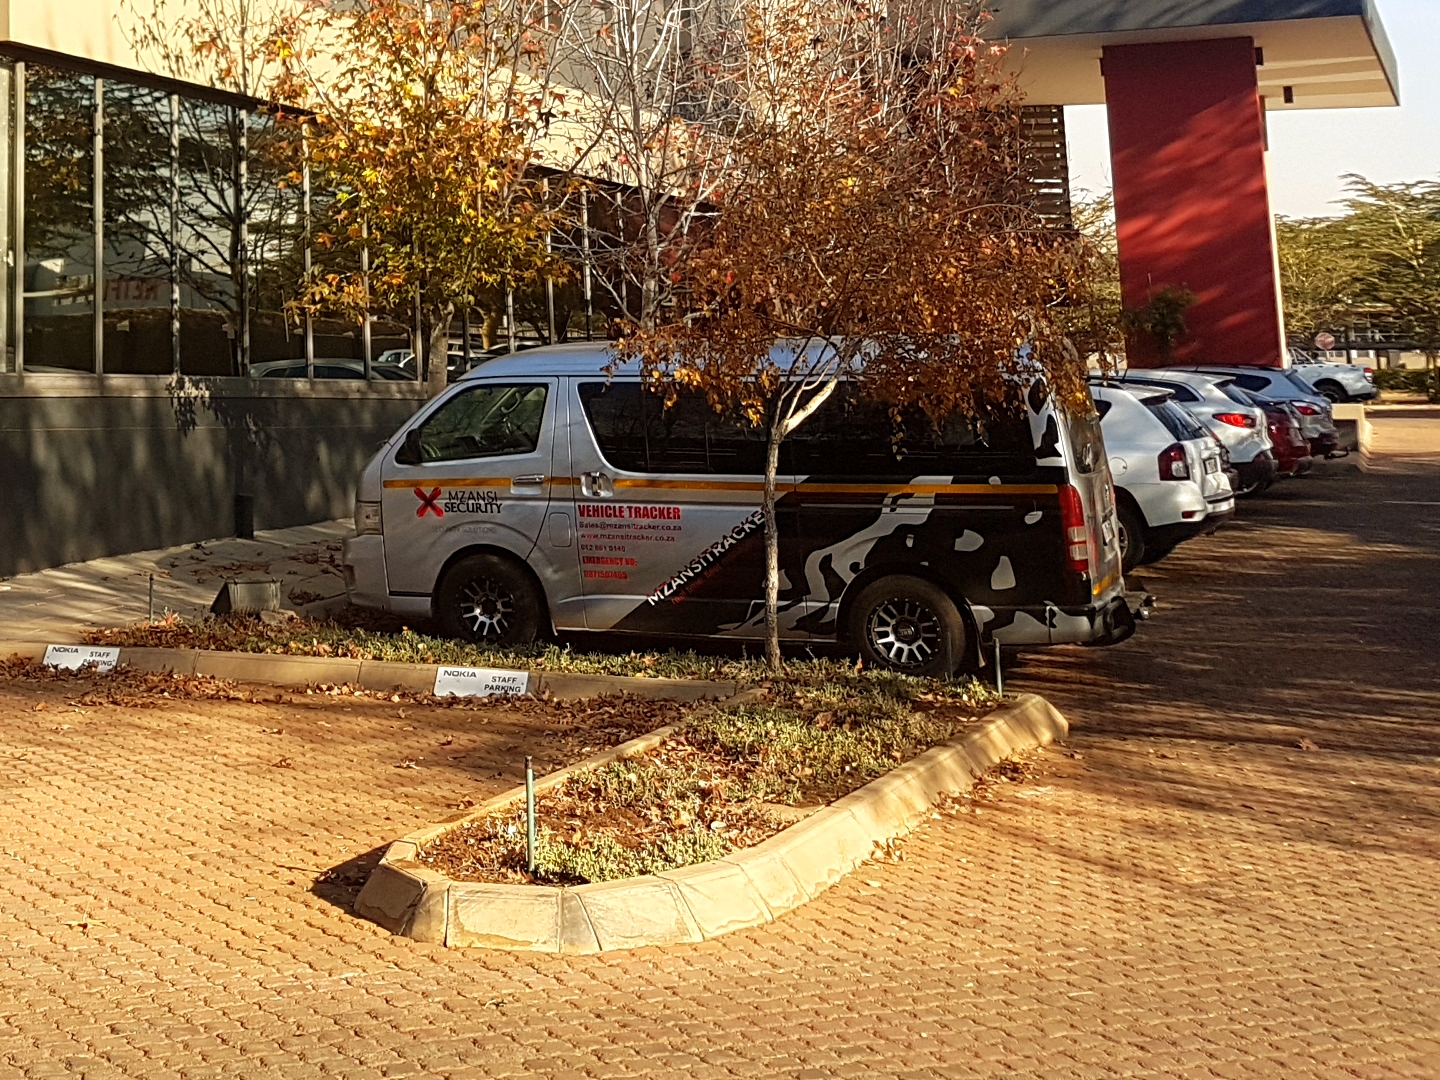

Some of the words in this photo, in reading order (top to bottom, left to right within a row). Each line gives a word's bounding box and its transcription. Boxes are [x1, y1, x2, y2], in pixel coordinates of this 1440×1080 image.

[448, 490, 498, 503] MZANSI
[444, 502, 503, 514] SECURITY
[577, 504, 625, 518] VEHICLE
[626, 505, 681, 520] TRACKER
[580, 532, 675, 542] www.mzansitracker.co.za
[582, 555, 623, 566] EMERGENCY
[624, 557, 638, 567] NO:
[646, 504, 766, 606] MZANSITRACKE
[51, 646, 79, 654] NOKIA
[443, 670, 477, 678] NOKIA
[491, 676, 518, 684] STAFF
[483, 684, 521, 693] PARKING
